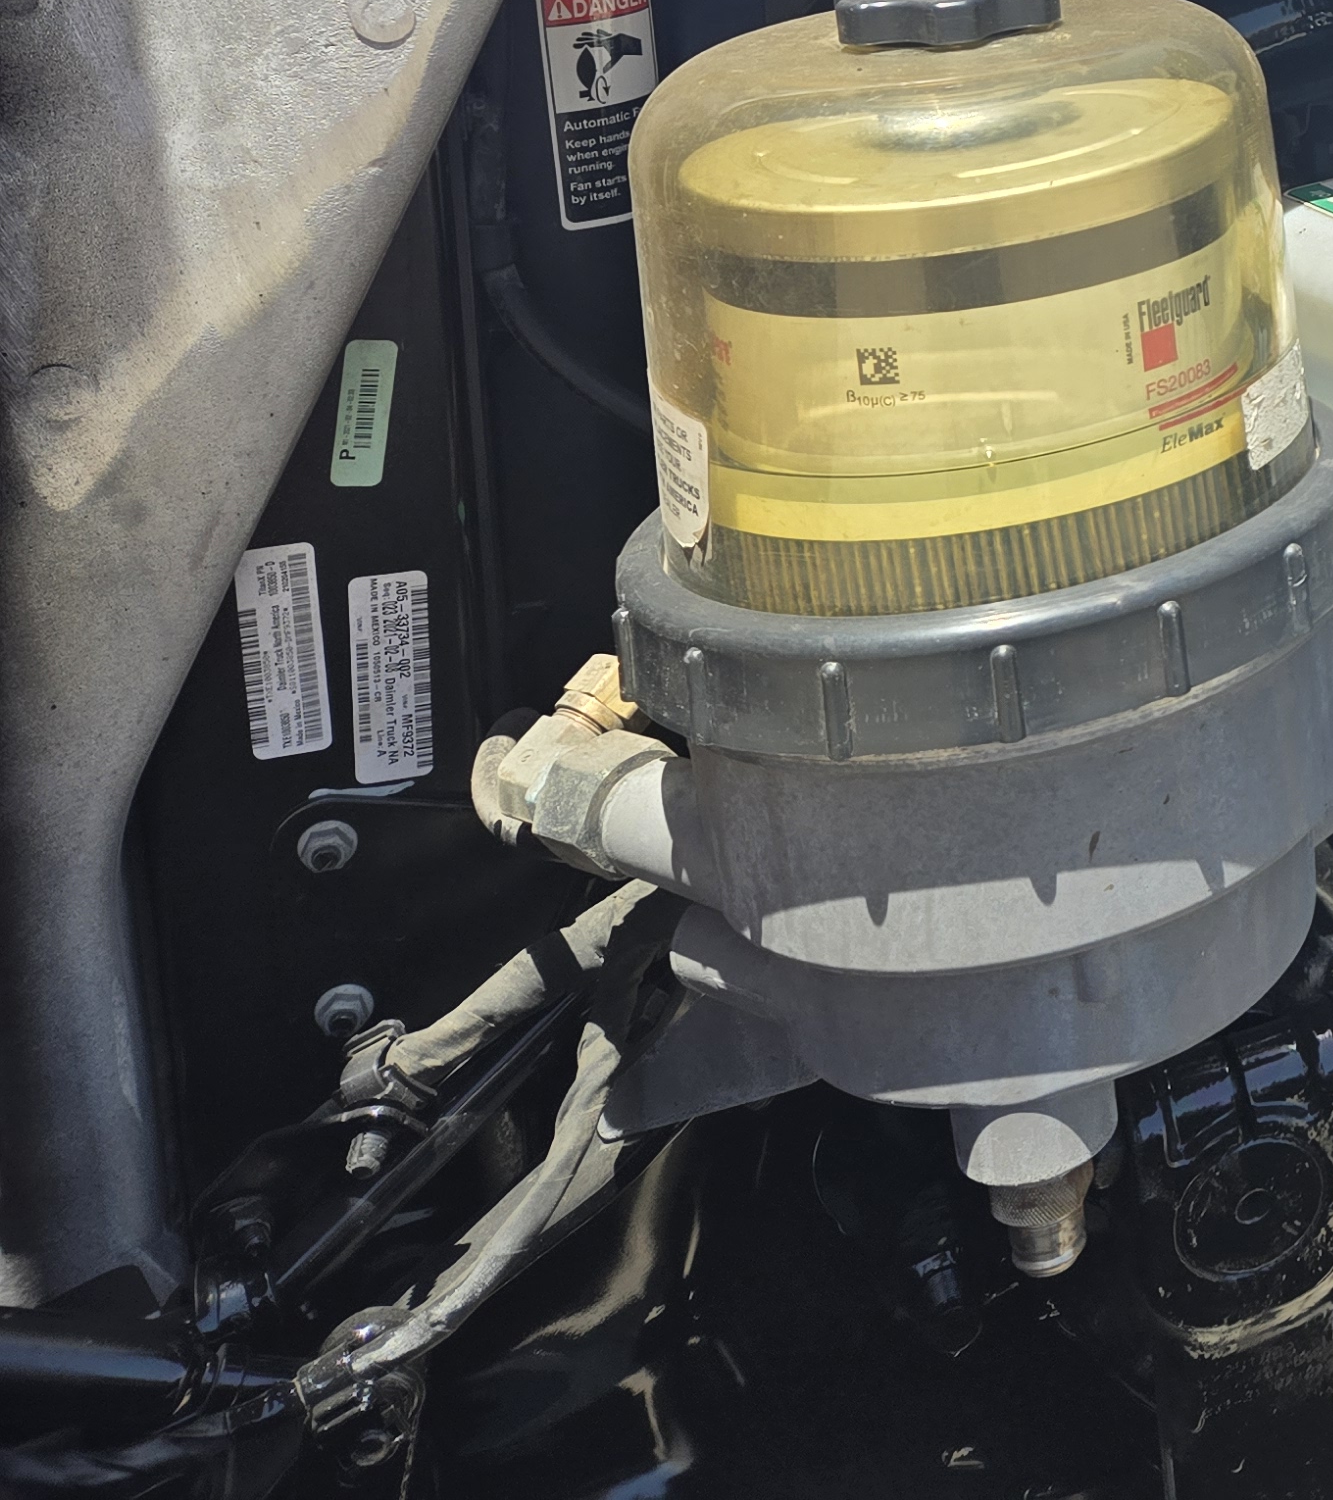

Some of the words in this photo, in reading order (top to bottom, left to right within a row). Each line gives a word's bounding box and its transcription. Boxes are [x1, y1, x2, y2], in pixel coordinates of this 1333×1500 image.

[563, 111, 631, 133] Automatic
[565, 136, 597, 150] Keep
[566, 148, 599, 163] when
[601, 144, 630, 158] engin
[570, 180, 592, 192] Fan
[594, 174, 628, 188] starts
[571, 194, 587, 206] by
[1137, 275, 1209, 332] Fleetguard
[1121, 312, 1131, 330] USA
[1124, 330, 1132, 341] IN
[1124, 342, 1134, 365] MADE
[1145, 358, 1212, 401] FS20083
[1160, 415, 1225, 454] EleMax
[669, 469, 701, 500] TRUCKS
[666, 484, 699, 517] AMERICA
[370, 578, 379, 602] MADE
[371, 603, 379, 613] IN
[370, 615, 381, 646] MEXICO
[396, 581, 412, 679] A05-33734-002
[384, 677, 396, 717] Daimler
[386, 718, 397, 748] Truck
[402, 713, 415, 758] MF9372
[377, 750, 387, 758] A
[388, 750, 399, 766] NA
